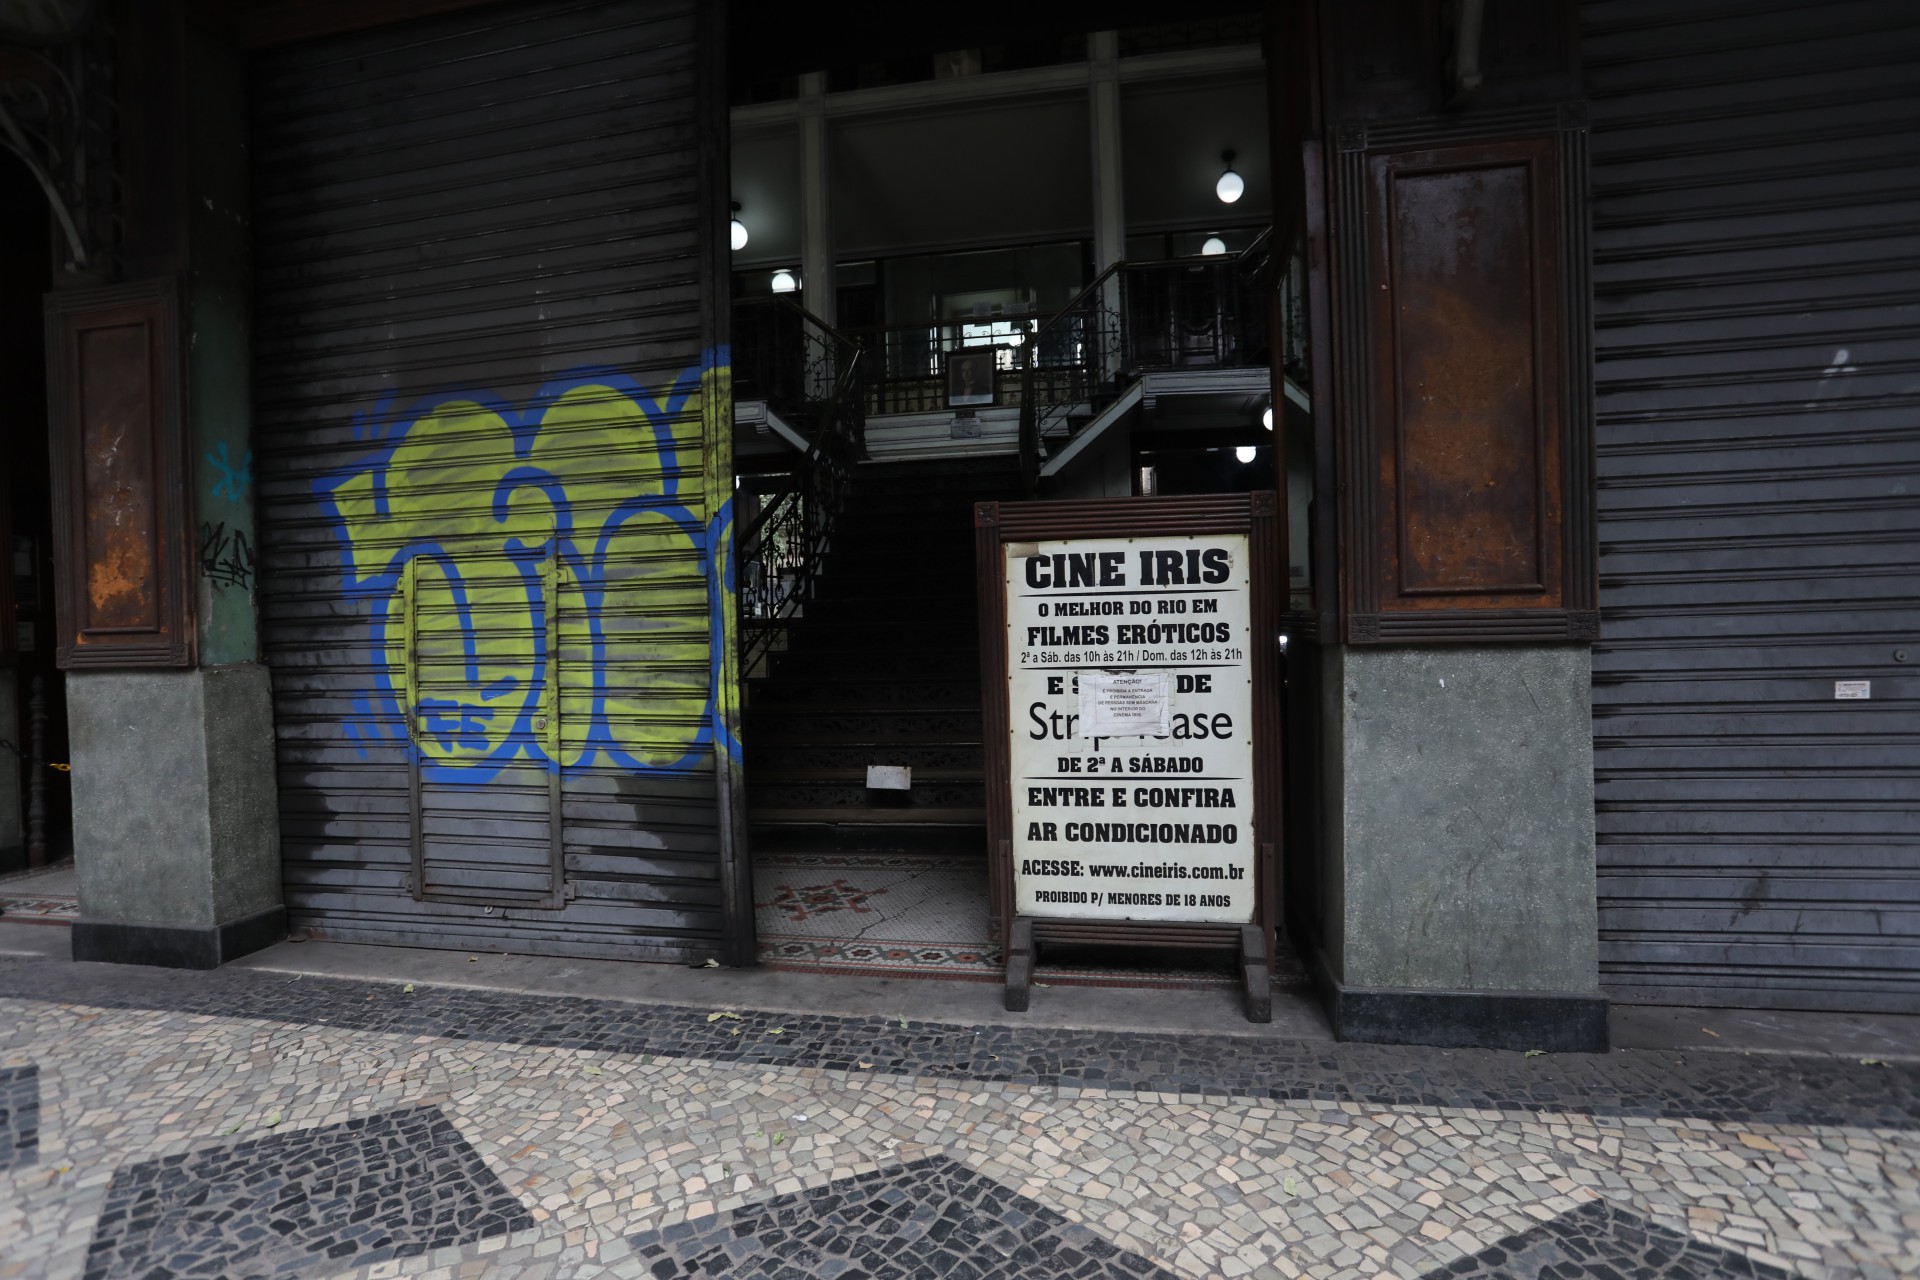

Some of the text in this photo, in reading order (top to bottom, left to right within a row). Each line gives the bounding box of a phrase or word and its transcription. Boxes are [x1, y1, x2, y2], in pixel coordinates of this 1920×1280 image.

[1025, 548, 1230, 589] CINE IRIS
[1038, 598, 1218, 617] O MELHOR DO RIO EM
[1027, 618, 1231, 646] FILMES ERÓTICOS
[1032, 654, 1039, 663] a
[1040, 650, 1062, 663] Sáb.
[1064, 651, 1081, 663] das
[1083, 650, 1101, 662] 10h
[1103, 650, 1114, 662] às
[1117, 650, 1134, 662] 21h
[1142, 649, 1168, 662] Dom.
[1170, 649, 1188, 661] das
[1190, 648, 1208, 661] 12h
[1210, 648, 1222, 660] às
[1224, 647, 1243, 660] 21h
[1047, 676, 1064, 695] E
[1176, 674, 1212, 694] DE
[1057, 756, 1081, 773] DE
[1110, 756, 1123, 773] A
[1128, 753, 1204, 773] SÁBADO
[1027, 787, 1236, 808] ENTRE E CONFIRA
[1027, 822, 1238, 845] AR CONDICIONADO
[1021, 859, 1245, 880] ACESSE: www.cineiris.com.br
[1035, 890, 1231, 908] PROIBIDO P/ MENORES DE 18 ANOS
